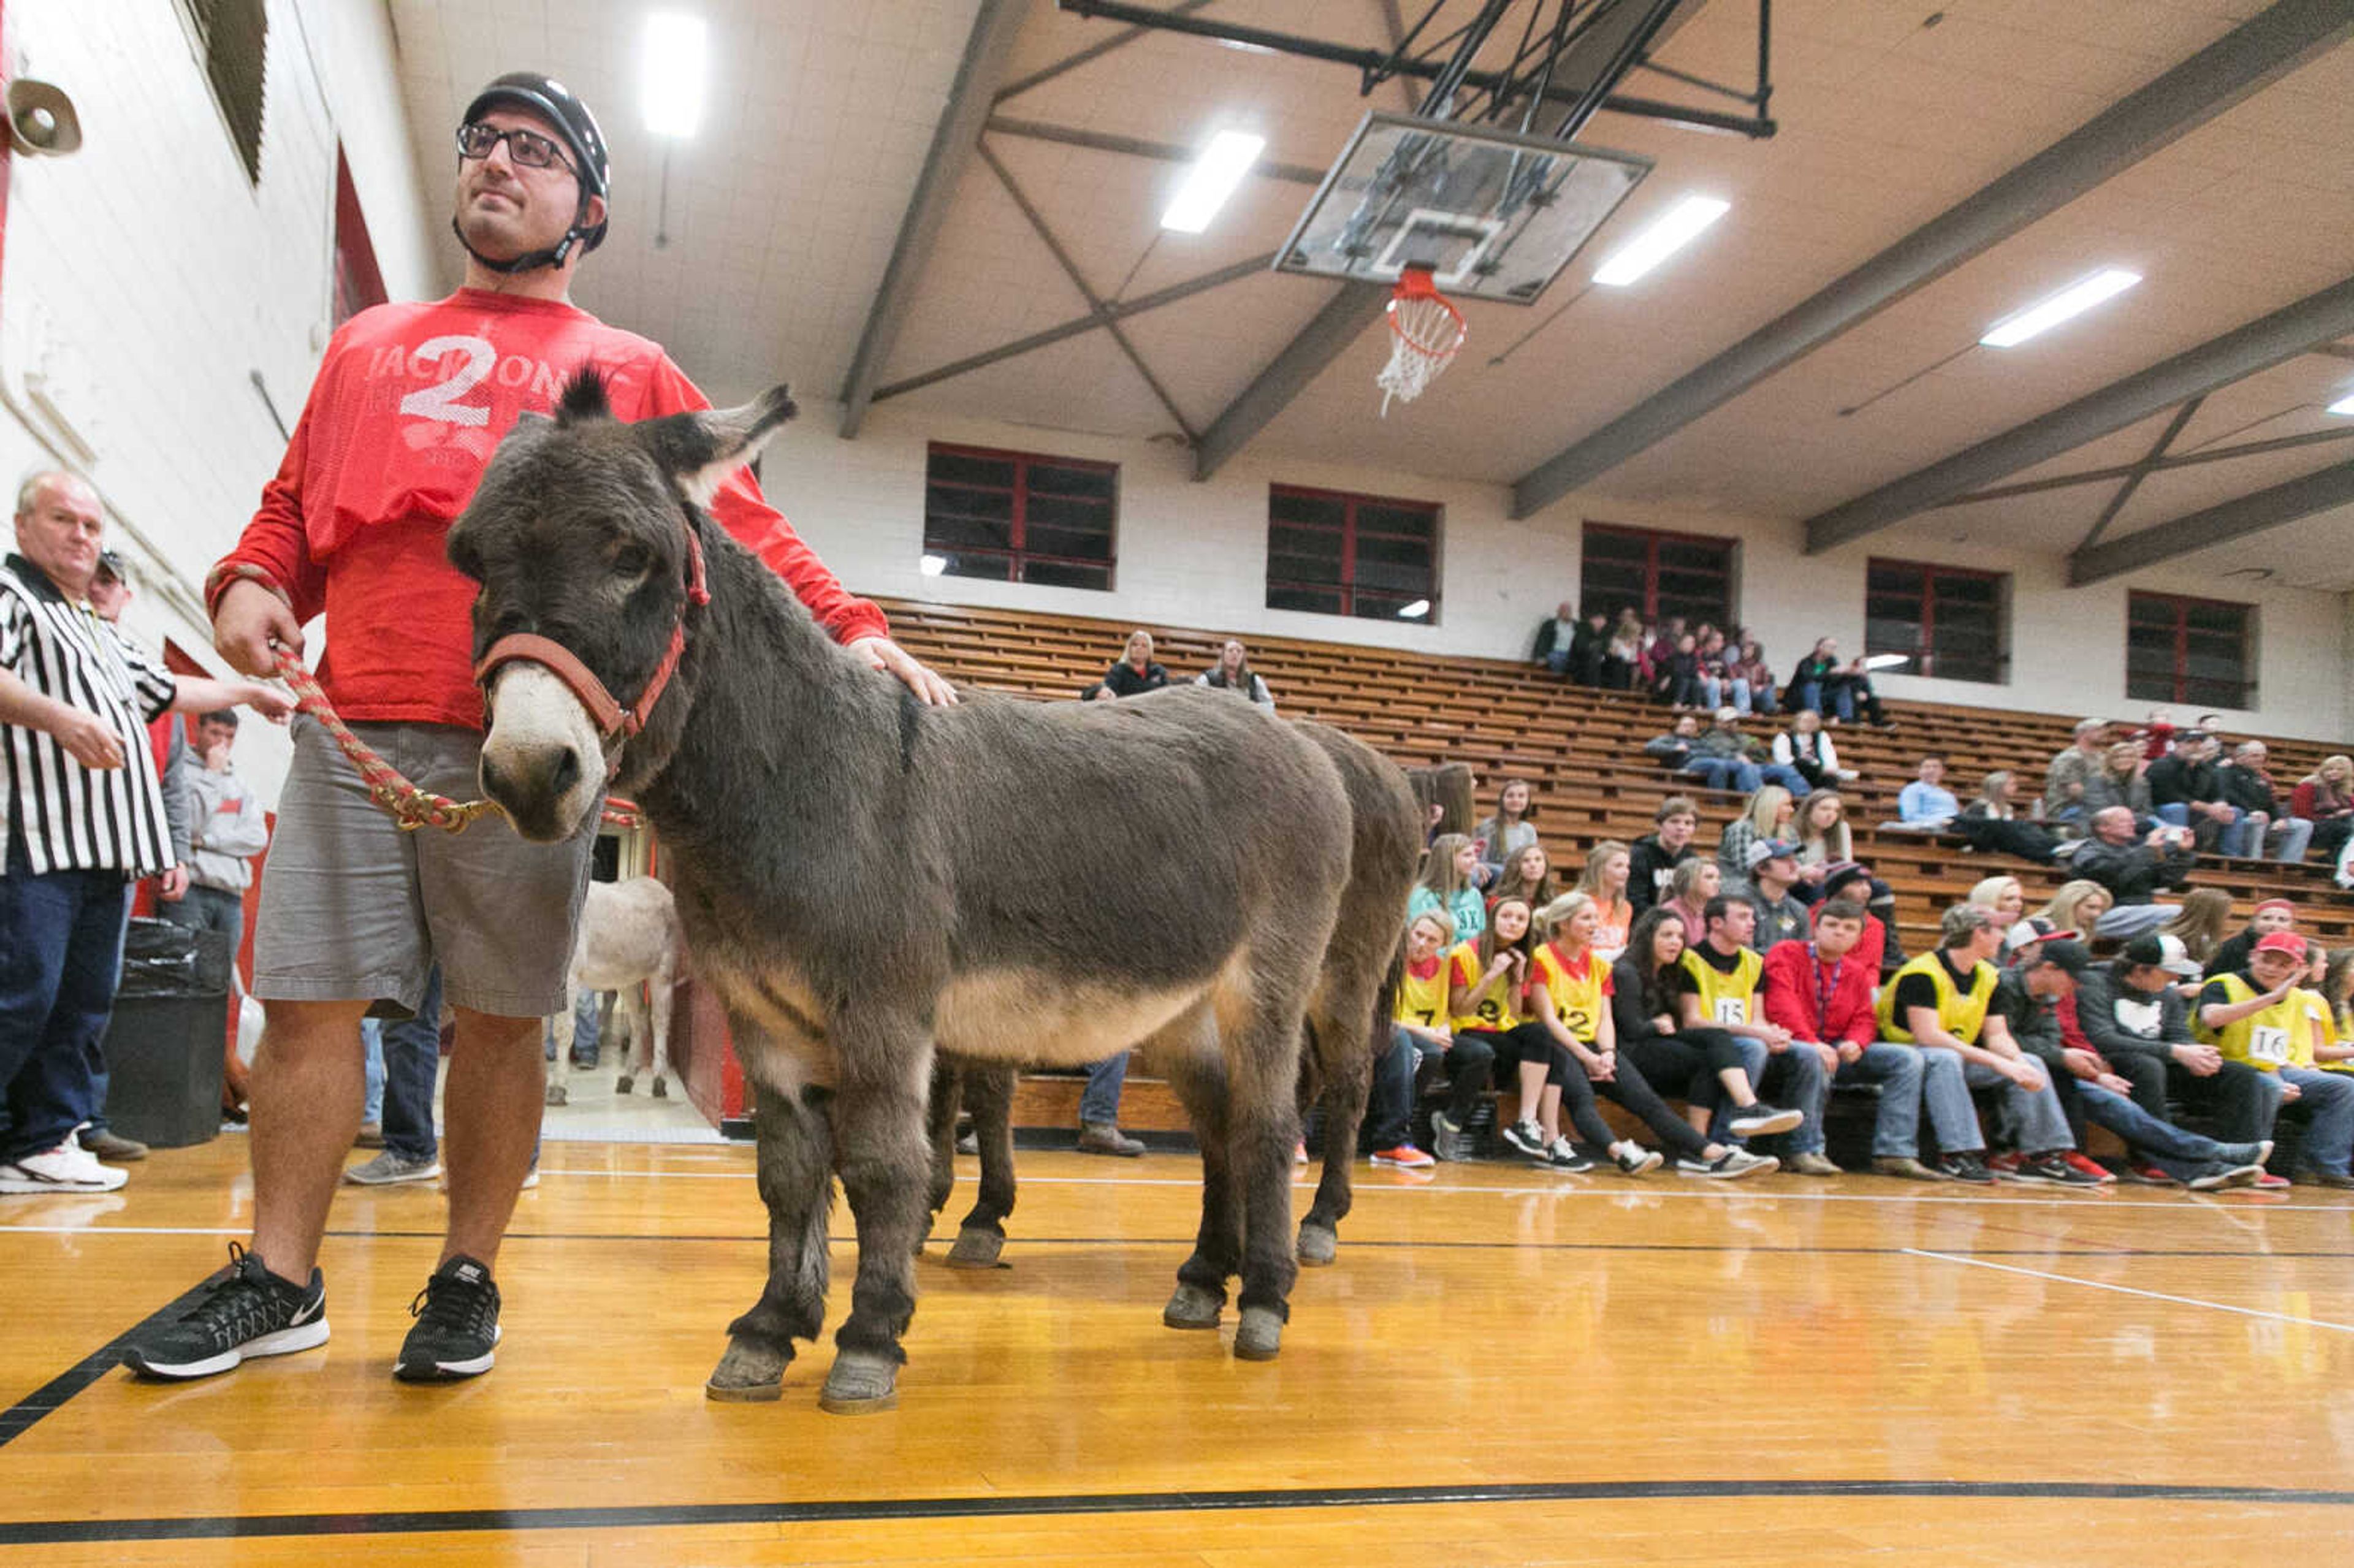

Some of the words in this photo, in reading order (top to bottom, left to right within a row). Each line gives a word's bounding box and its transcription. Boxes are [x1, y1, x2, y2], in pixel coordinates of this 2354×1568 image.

[400, 334, 497, 427] 2
[1415, 1010, 1434, 1026] 7
[1722, 1004, 1744, 1025] 15
[2256, 1031, 2285, 1059] 16
